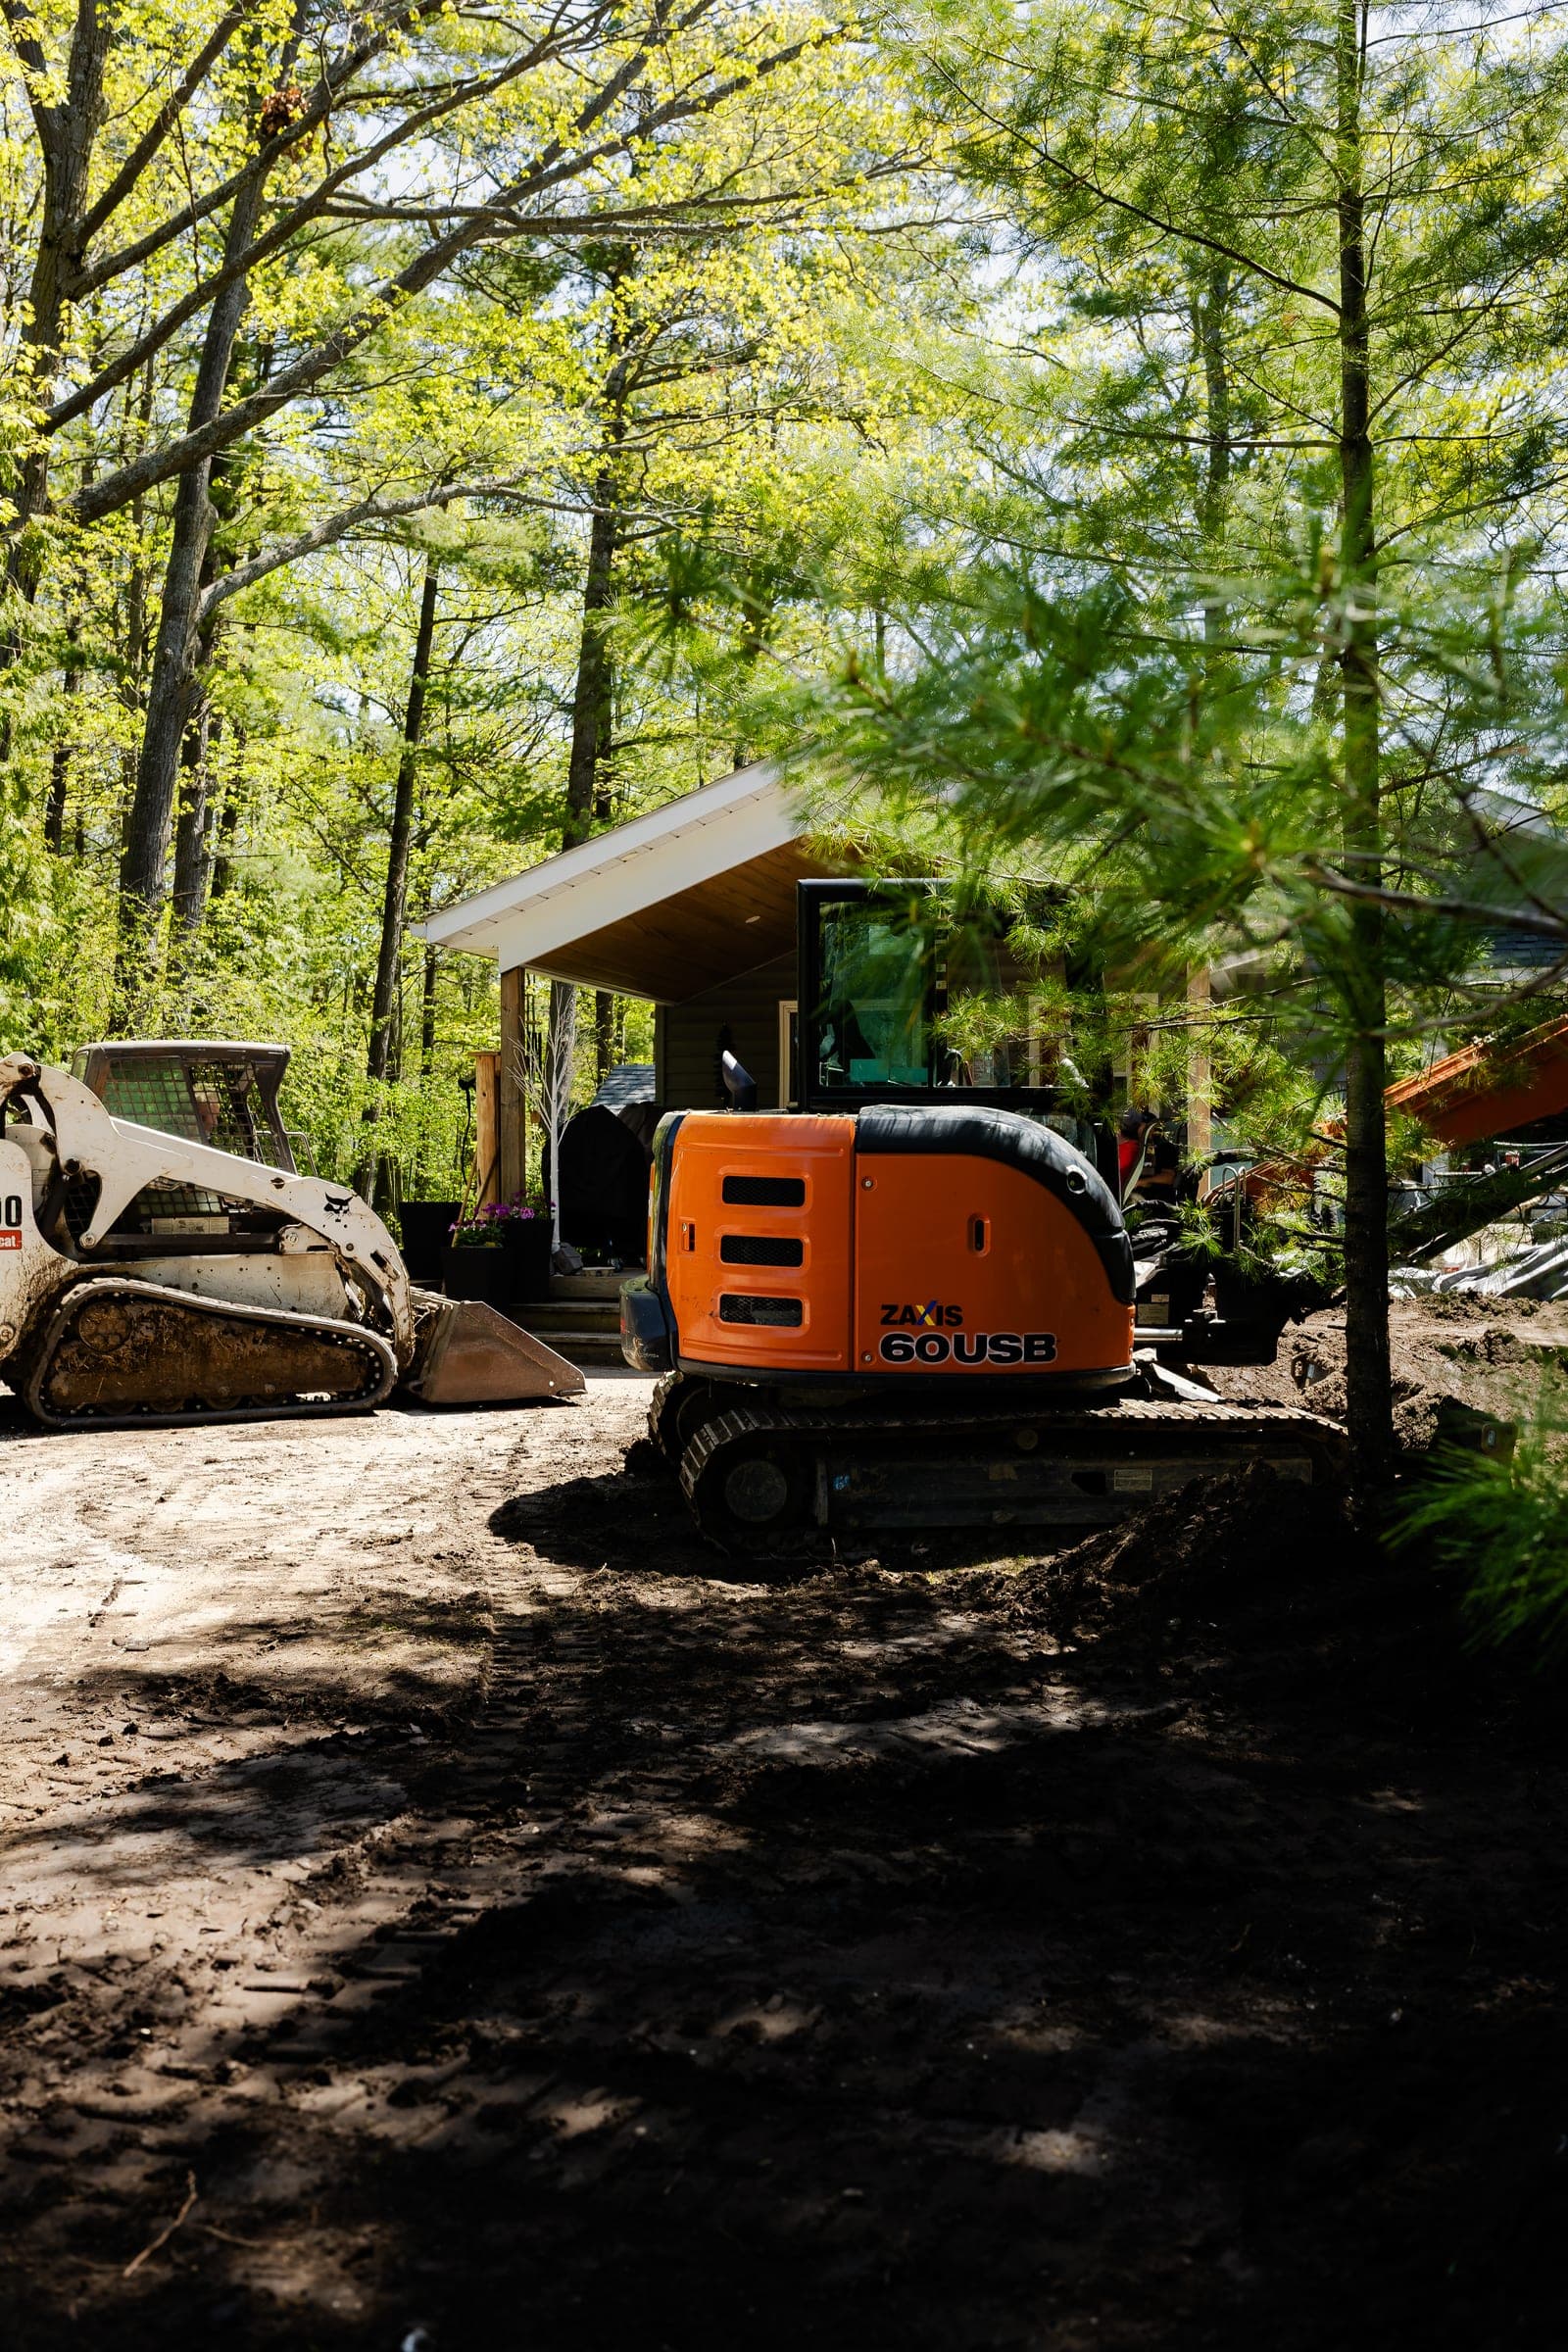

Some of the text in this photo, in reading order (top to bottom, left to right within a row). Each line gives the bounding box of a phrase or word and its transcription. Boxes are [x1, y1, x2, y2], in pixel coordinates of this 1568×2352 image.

[0, 1196, 22, 1227] 0
[880, 1300, 963, 1327] ZAXIS
[879, 1332, 1057, 1366] 60USB
